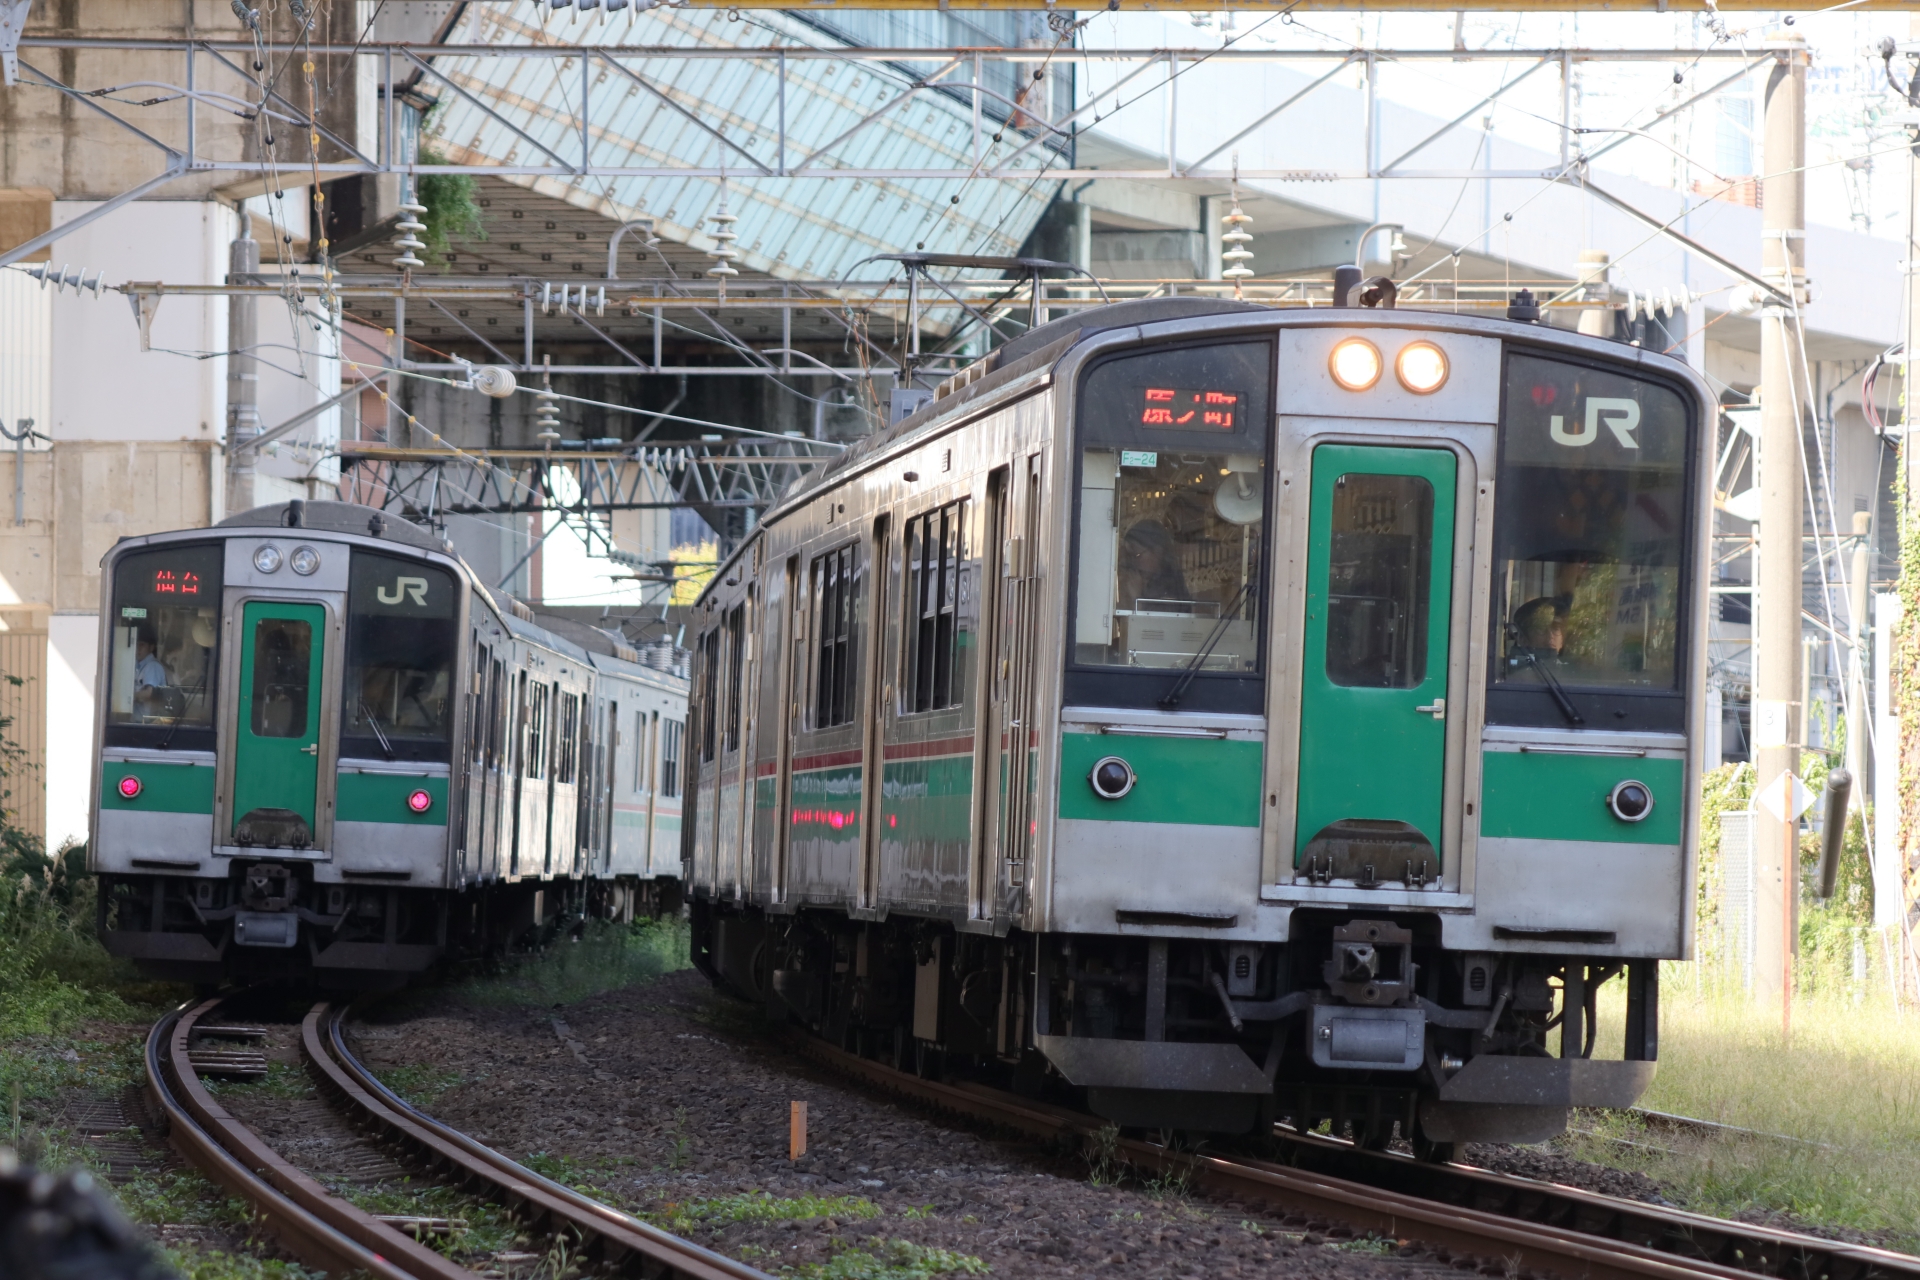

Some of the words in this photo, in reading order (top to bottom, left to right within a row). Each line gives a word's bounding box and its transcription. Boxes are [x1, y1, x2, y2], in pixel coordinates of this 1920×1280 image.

[1143, 388, 1237, 427] 原ノ町
[1550, 396, 1641, 449] JR
[156, 570, 199, 593] 仙台
[377, 576, 428, 606] JR
